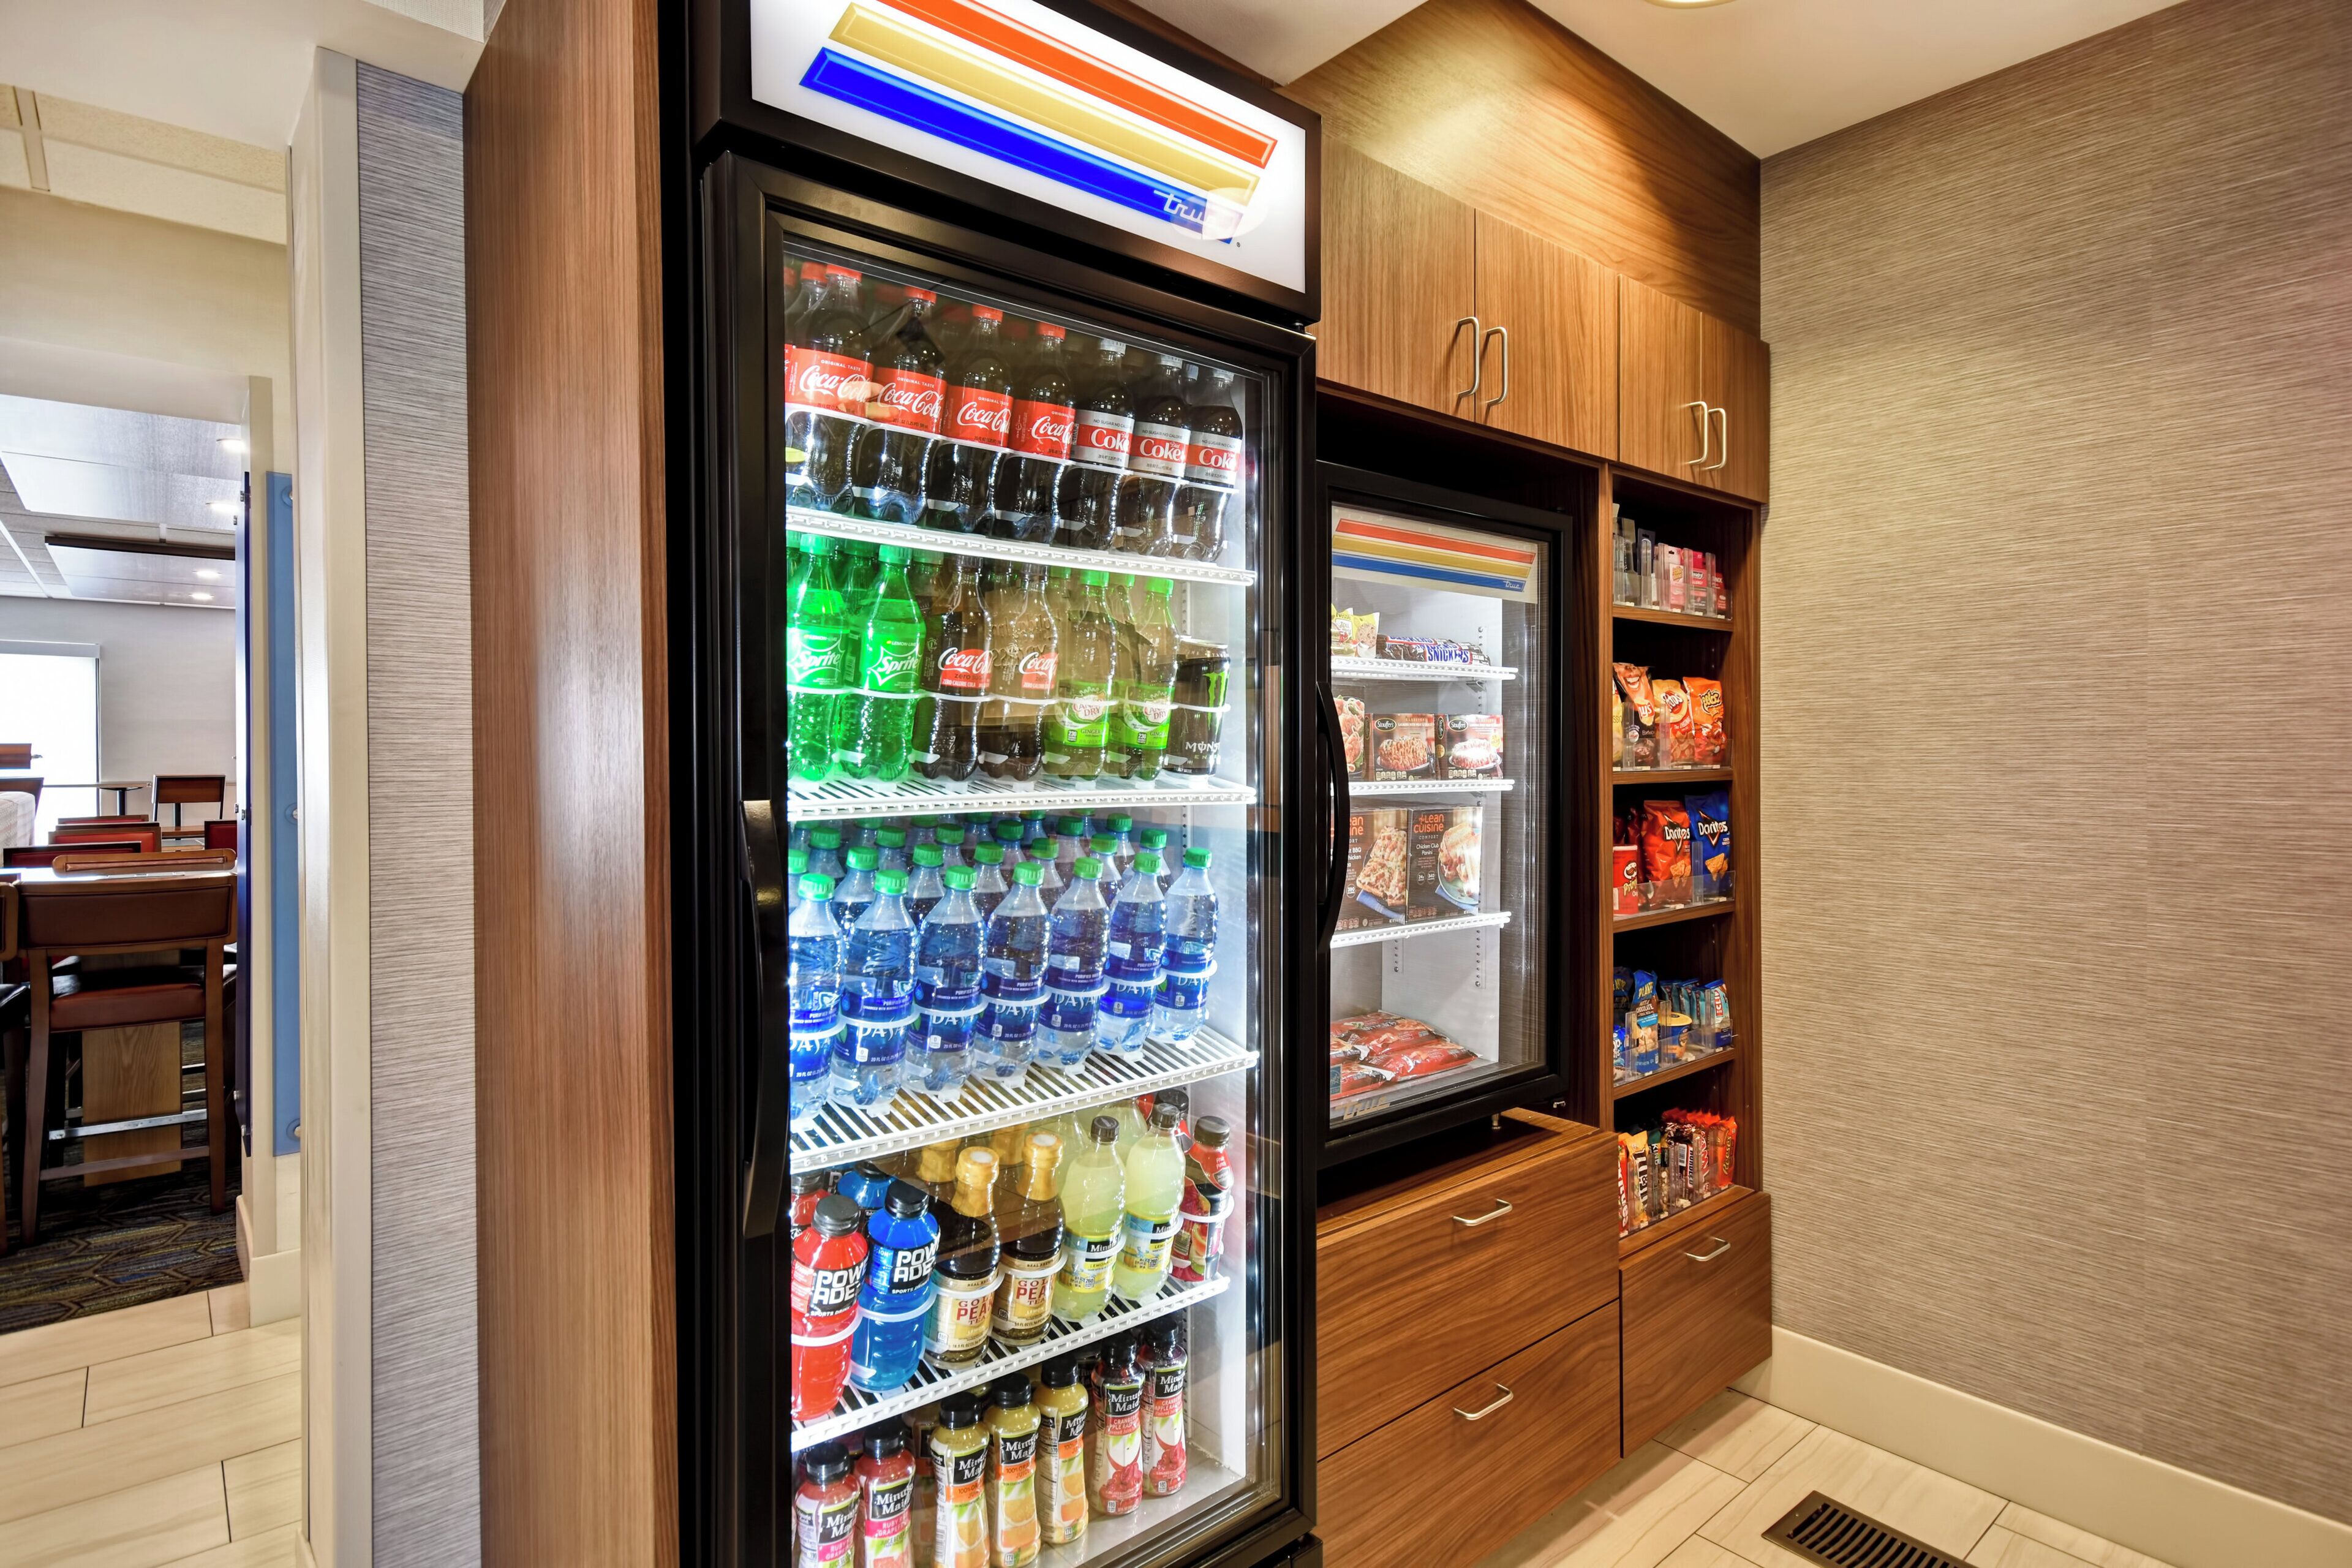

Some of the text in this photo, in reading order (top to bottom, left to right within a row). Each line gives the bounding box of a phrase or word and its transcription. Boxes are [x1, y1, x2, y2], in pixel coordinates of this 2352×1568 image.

[821, 359, 846, 368] ORIGINAL
[897, 377, 921, 385] ORIGINAL
[877, 382, 944, 418] Coca-Cola
[1140, 439, 1182, 462] Coke
[798, 650, 841, 669] Sprite
[1428, 649, 1469, 663] SNICKERS
[877, 656, 919, 674] Sprite
[1084, 707, 1100, 717] DRY
[1425, 813, 1444, 824] Lean
[1665, 826, 1691, 840] Doritos
[1698, 821, 1728, 835] Doritos
[968, 1316, 986, 1325] TEA
[1115, 1396, 1140, 1412] Maid
